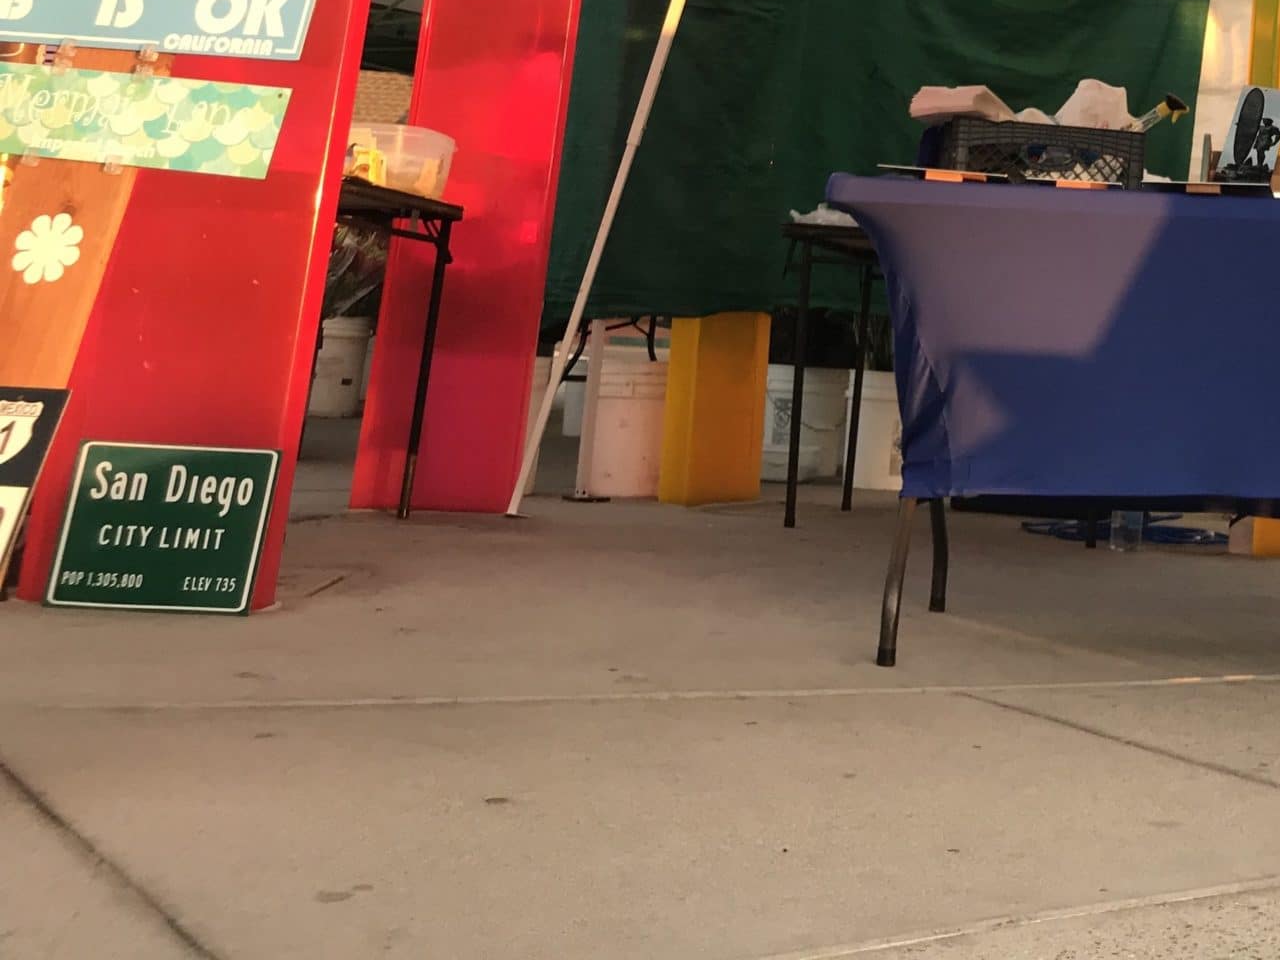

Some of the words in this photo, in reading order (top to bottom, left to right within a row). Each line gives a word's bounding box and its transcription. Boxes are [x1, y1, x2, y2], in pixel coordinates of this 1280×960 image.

[163, 32, 273, 56] CALIFORNIA
[90, 461, 149, 501] San
[165, 465, 254, 518] Diego
[98, 524, 154, 548] CITY
[158, 527, 225, 551] LIMIT
[60, 571, 83, 586] POP
[183, 577, 212, 592] ELEV
[214, 578, 237, 592] 735
